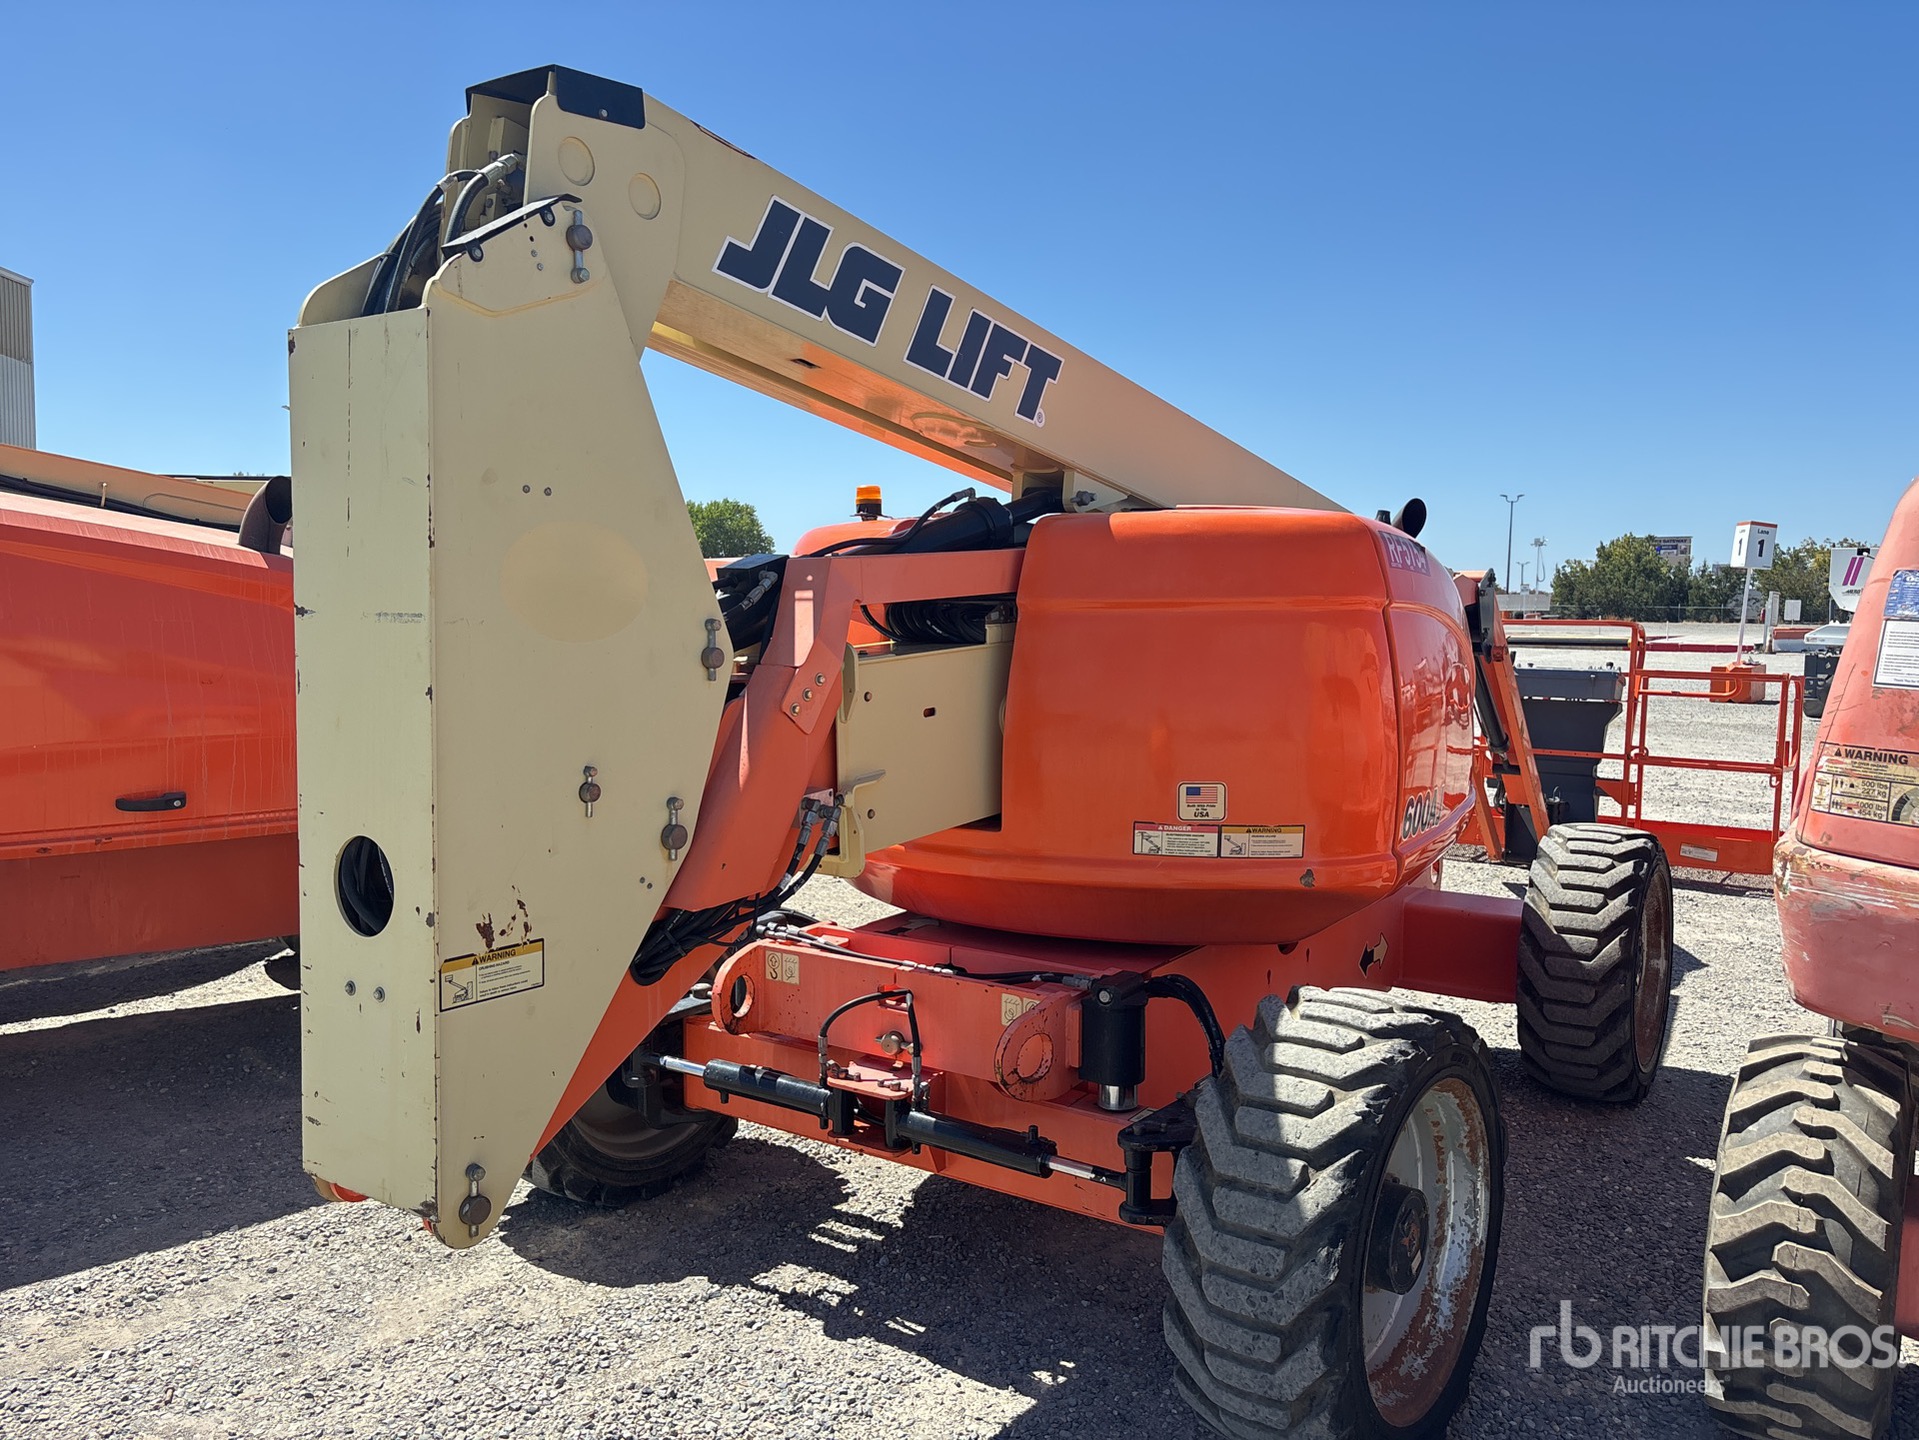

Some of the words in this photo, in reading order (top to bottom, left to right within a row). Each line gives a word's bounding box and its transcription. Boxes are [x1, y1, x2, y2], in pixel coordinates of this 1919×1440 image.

[712, 195, 905, 347] JLG
[904, 285, 1064, 424] LIFT
[1758, 539, 1765, 557] 1
[1845, 748, 1909, 765] WARNING
[1861, 780, 1875, 788] 500
[1877, 781, 1888, 790] lbs
[1877, 788, 1887, 798] kg
[1875, 803, 1886, 811] lbs
[1873, 810, 1883, 819] kg
[479, 949, 516, 964] WARNING
